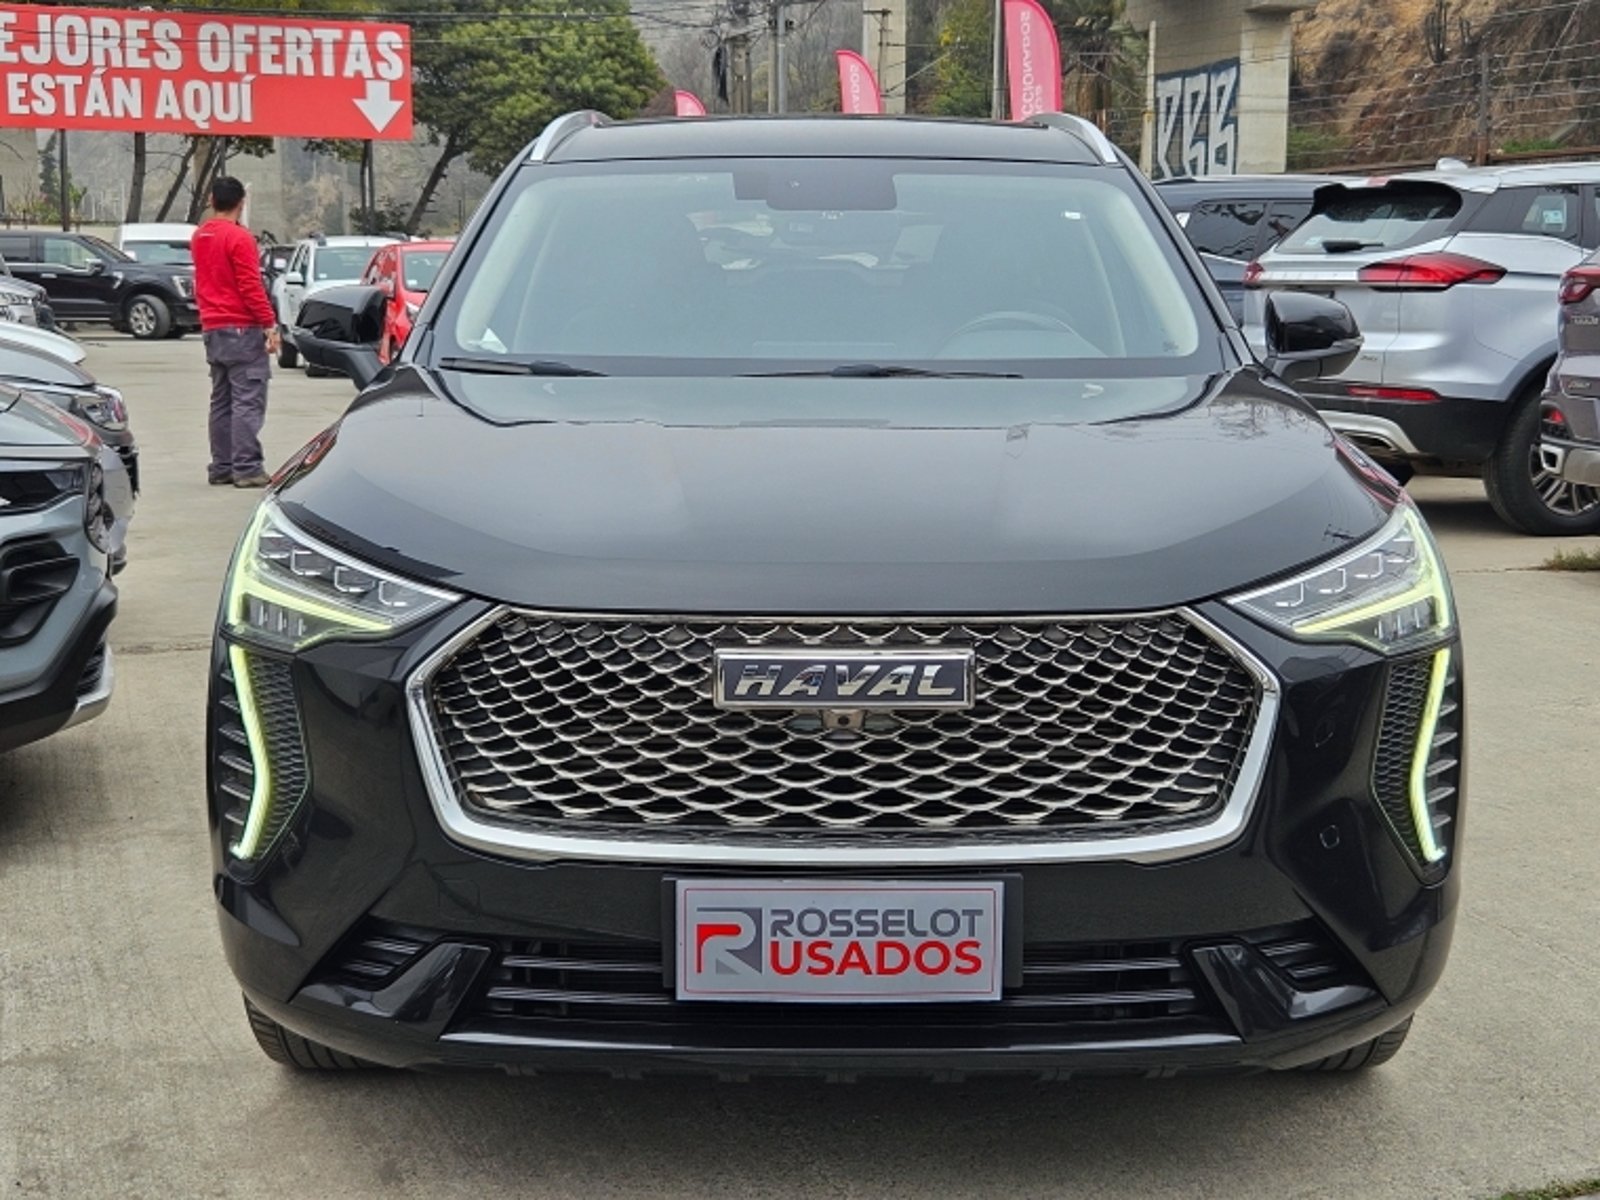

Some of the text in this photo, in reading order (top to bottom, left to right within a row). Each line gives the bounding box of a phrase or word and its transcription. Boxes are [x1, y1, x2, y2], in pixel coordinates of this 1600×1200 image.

[198, 22, 404, 80] OFERTAS
[7, 69, 255, 128] ESTÁN AQUÍ
[734, 664, 956, 696] HAVAL
[770, 908, 984, 937] ROSSELOT
[770, 940, 982, 975] USADOS
